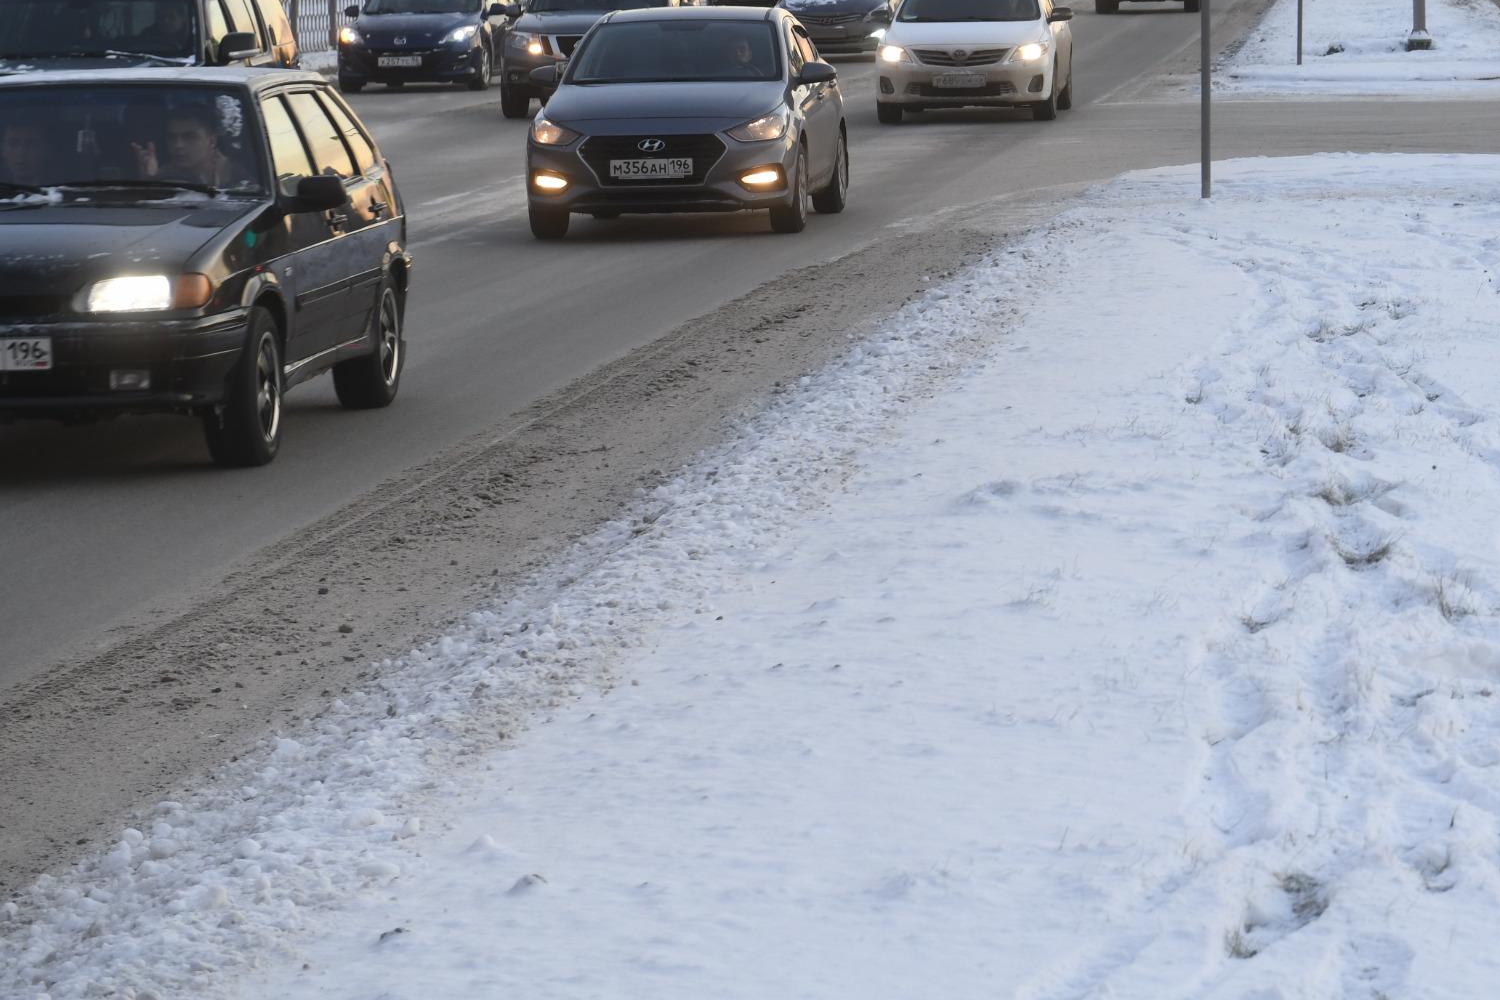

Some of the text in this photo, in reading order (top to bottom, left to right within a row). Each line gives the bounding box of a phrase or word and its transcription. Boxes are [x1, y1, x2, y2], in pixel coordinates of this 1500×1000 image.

[613, 160, 690, 175] М356АН 196
[7, 341, 42, 360] 196
